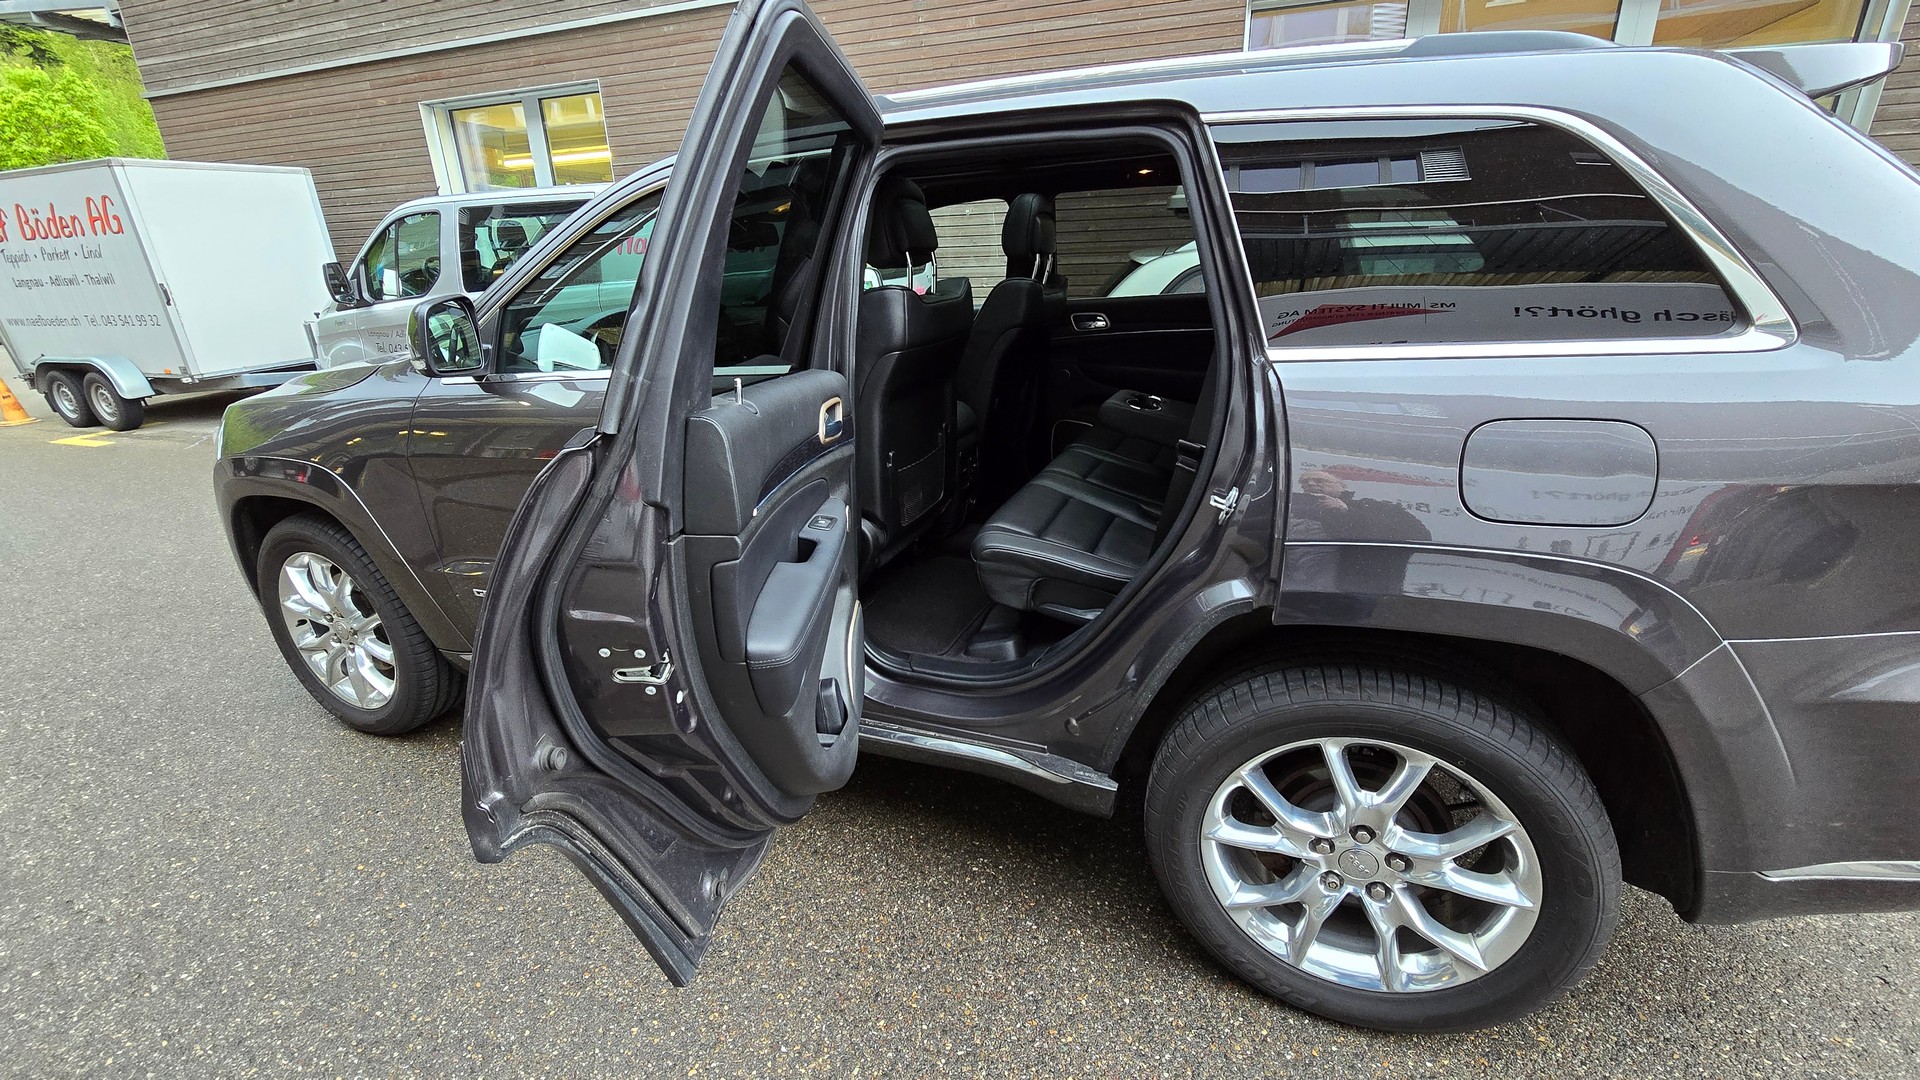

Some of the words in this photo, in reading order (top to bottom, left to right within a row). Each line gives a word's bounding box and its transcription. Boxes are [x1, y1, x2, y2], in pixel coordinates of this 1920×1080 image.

[14, 202, 85, 241] Böden
[85, 194, 124, 237] AG
[0, 248, 31, 269] Teppich
[40, 246, 71, 262] Parkett
[80, 243, 103, 260] Linol
[12, 277, 44, 290] Langnau
[49, 274, 80, 287] Adliswil
[84, 272, 116, 286] Thalwil
[5, 314, 81, 327] www.naefboeden.ch
[100, 314, 118, 327] 043
[117, 314, 136, 327] 541
[136, 314, 148, 327] 99
[149, 314, 161, 327] 32
